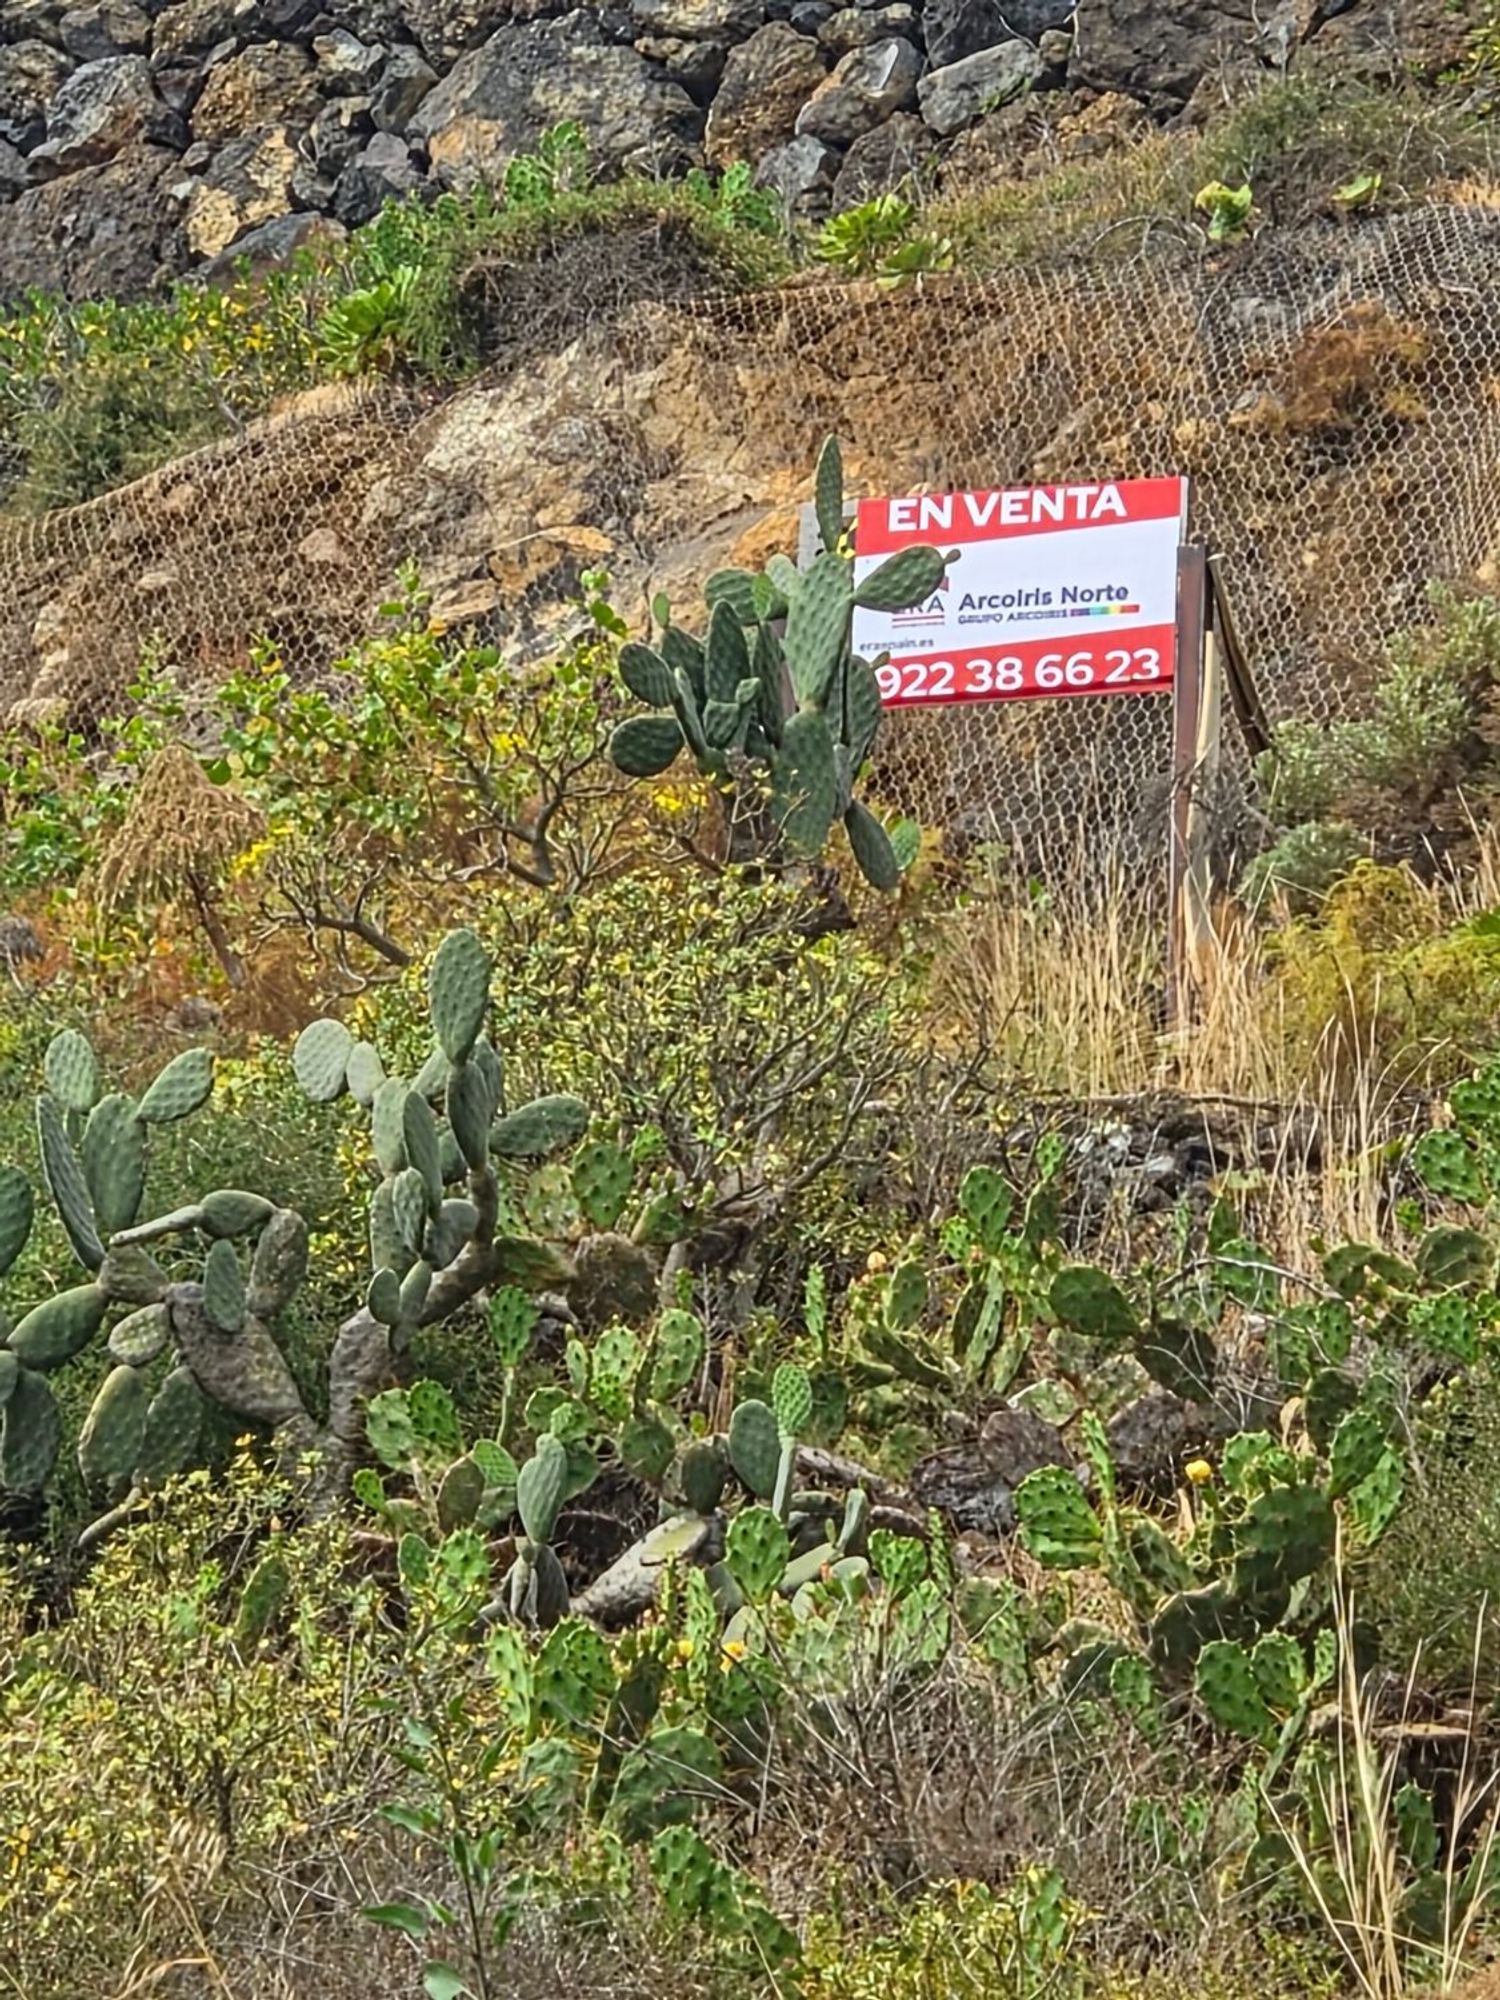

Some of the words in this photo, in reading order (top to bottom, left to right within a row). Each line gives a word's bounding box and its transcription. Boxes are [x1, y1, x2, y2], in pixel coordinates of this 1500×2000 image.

[888, 496, 952, 532] EN
[963, 485, 1127, 527] VENTA
[1061, 584, 1128, 604] Norte
[876, 661, 955, 699] 922
[965, 657, 1024, 693] 38
[1034, 651, 1094, 688] 66
[1104, 648, 1160, 683] 23
